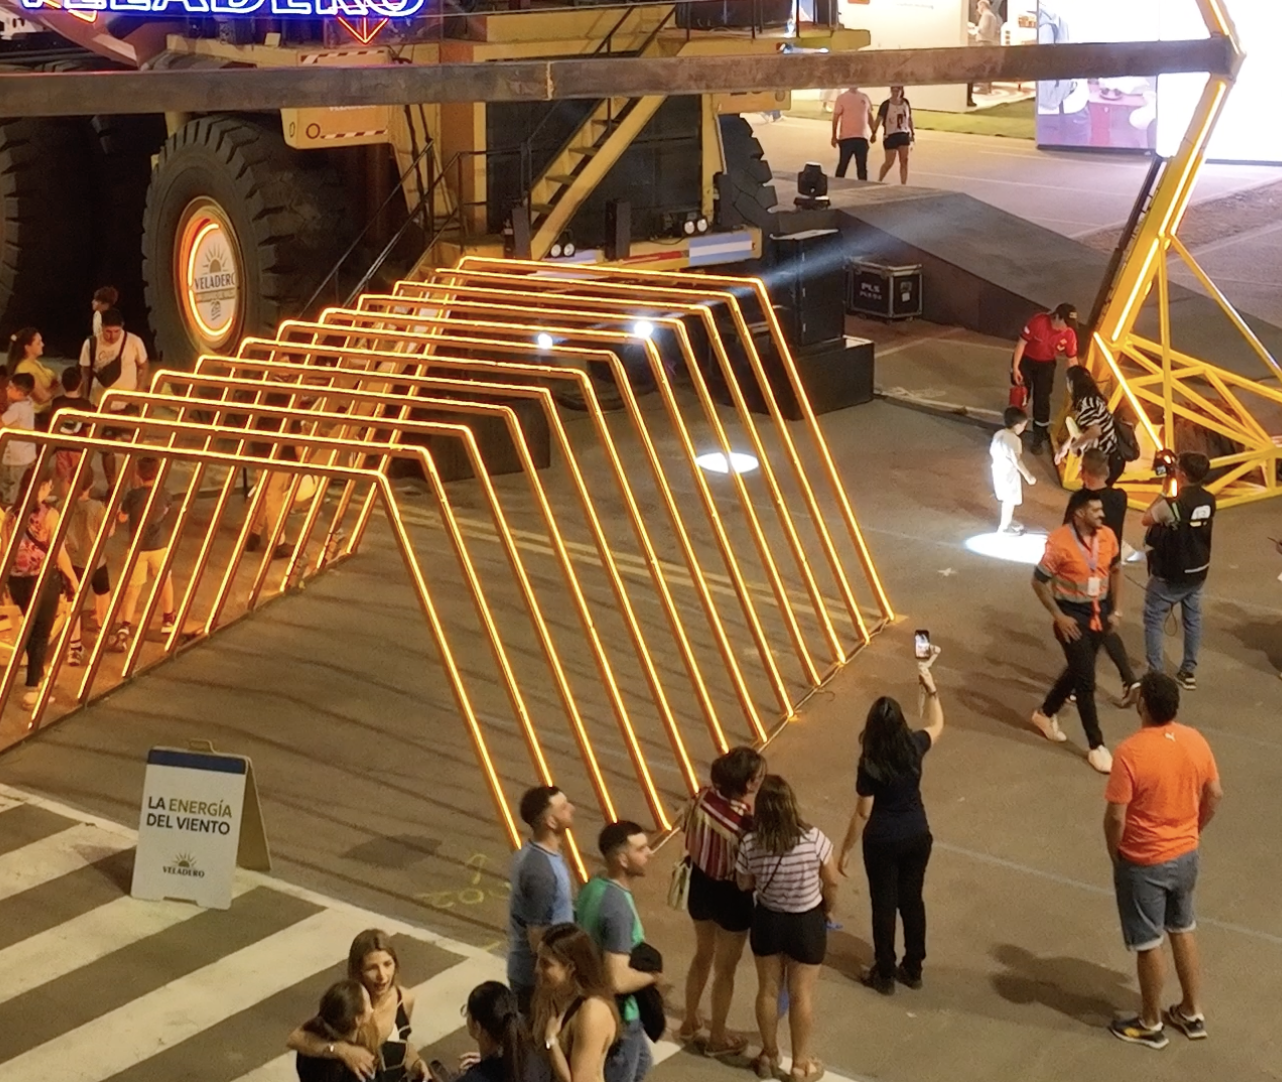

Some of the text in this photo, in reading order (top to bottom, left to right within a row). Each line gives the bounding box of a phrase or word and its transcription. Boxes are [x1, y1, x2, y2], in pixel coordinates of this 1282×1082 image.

[148, 796, 232, 818] LA ENERGÍA
[146, 813, 230, 835] DEL VIENTO
[162, 866, 205, 879] VELADERO
